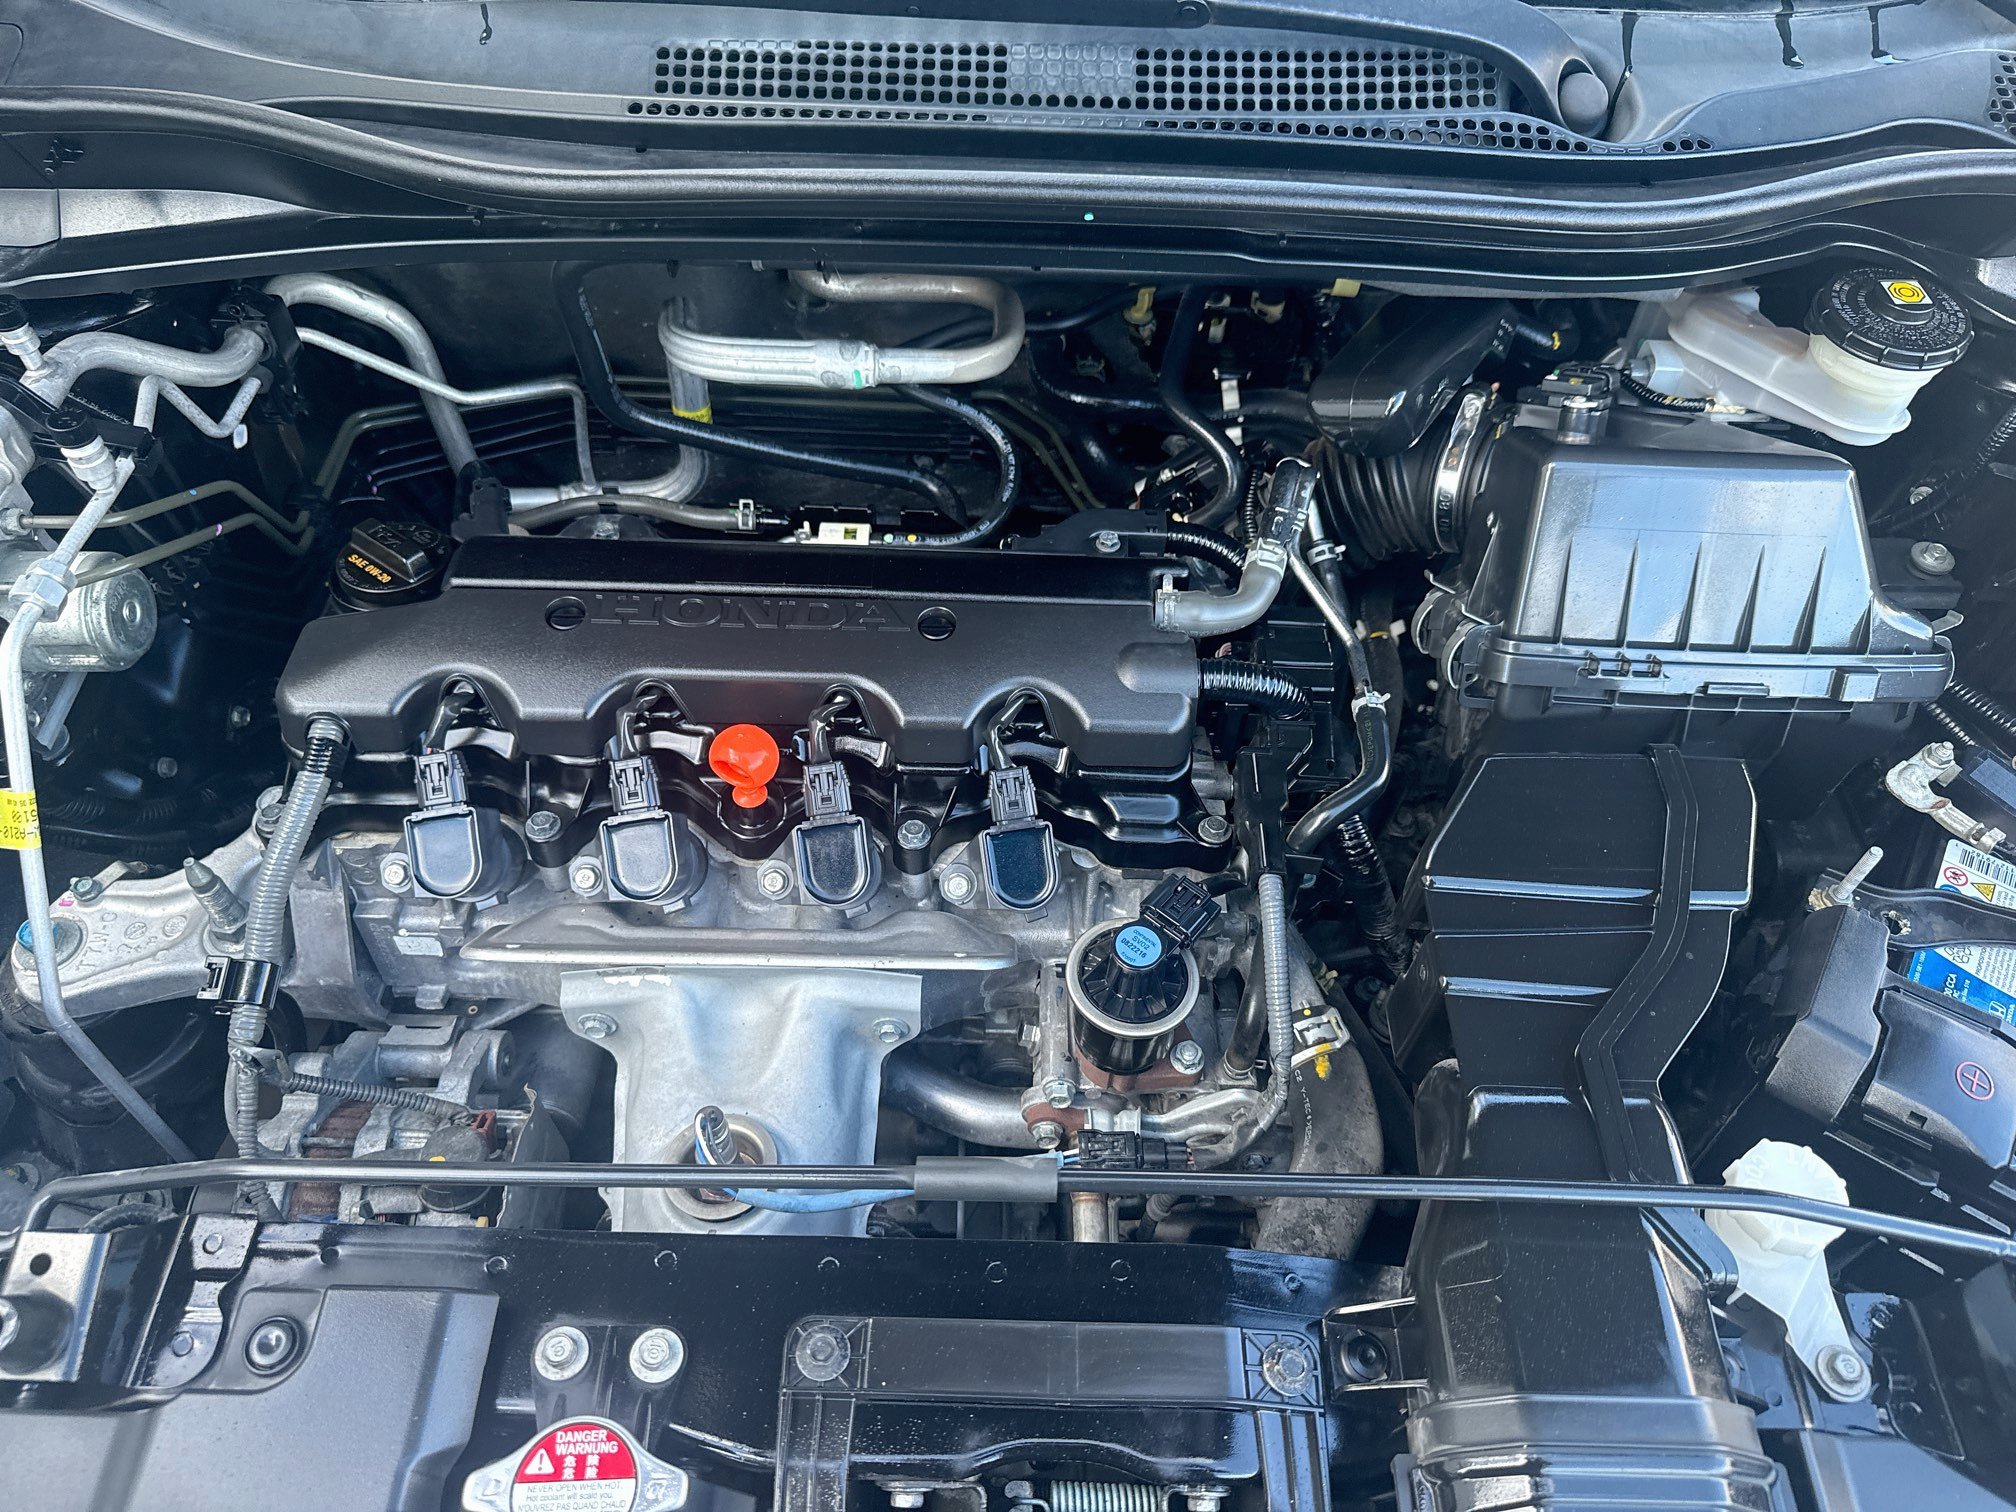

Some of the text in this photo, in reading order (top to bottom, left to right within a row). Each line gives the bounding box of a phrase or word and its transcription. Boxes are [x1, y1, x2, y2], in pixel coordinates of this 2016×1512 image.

[348, 554, 370, 568] SAE
[364, 564, 392, 584] 0W-20
[590, 594, 911, 631] HONDA
[1132, 936, 1150, 950] SV02
[1946, 974, 1958, 988] CCA
[555, 1429, 607, 1443] DANGER
[555, 1441, 618, 1455] WARNUNG
[556, 1483, 577, 1491] OPEN
[580, 1482, 602, 1490] WHEN
[557, 1502, 570, 1510] PAS
